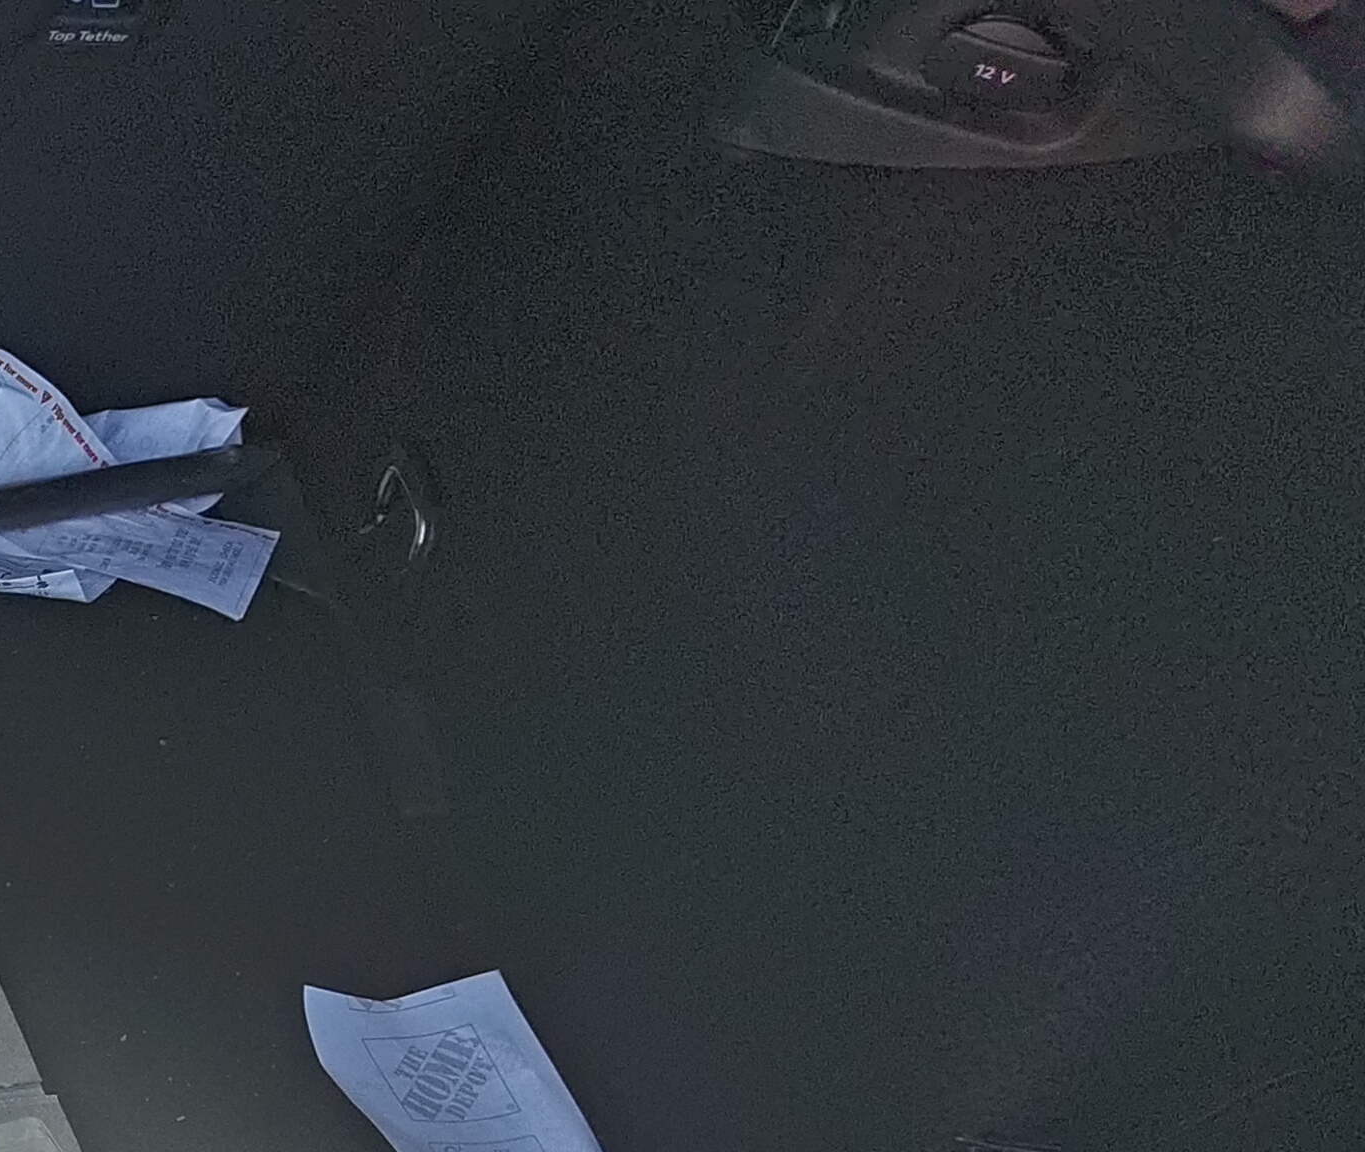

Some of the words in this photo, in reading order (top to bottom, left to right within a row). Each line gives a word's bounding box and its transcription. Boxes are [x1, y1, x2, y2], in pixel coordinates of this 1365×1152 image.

[48, 30, 76, 44] Top
[79, 30, 129, 43] Tether
[973, 63, 996, 80] 12
[1000, 70, 1017, 84] V
[394, 1045, 429, 1080] THE
[400, 1030, 481, 1121] HOME
[445, 1056, 493, 1120] DEPOT
